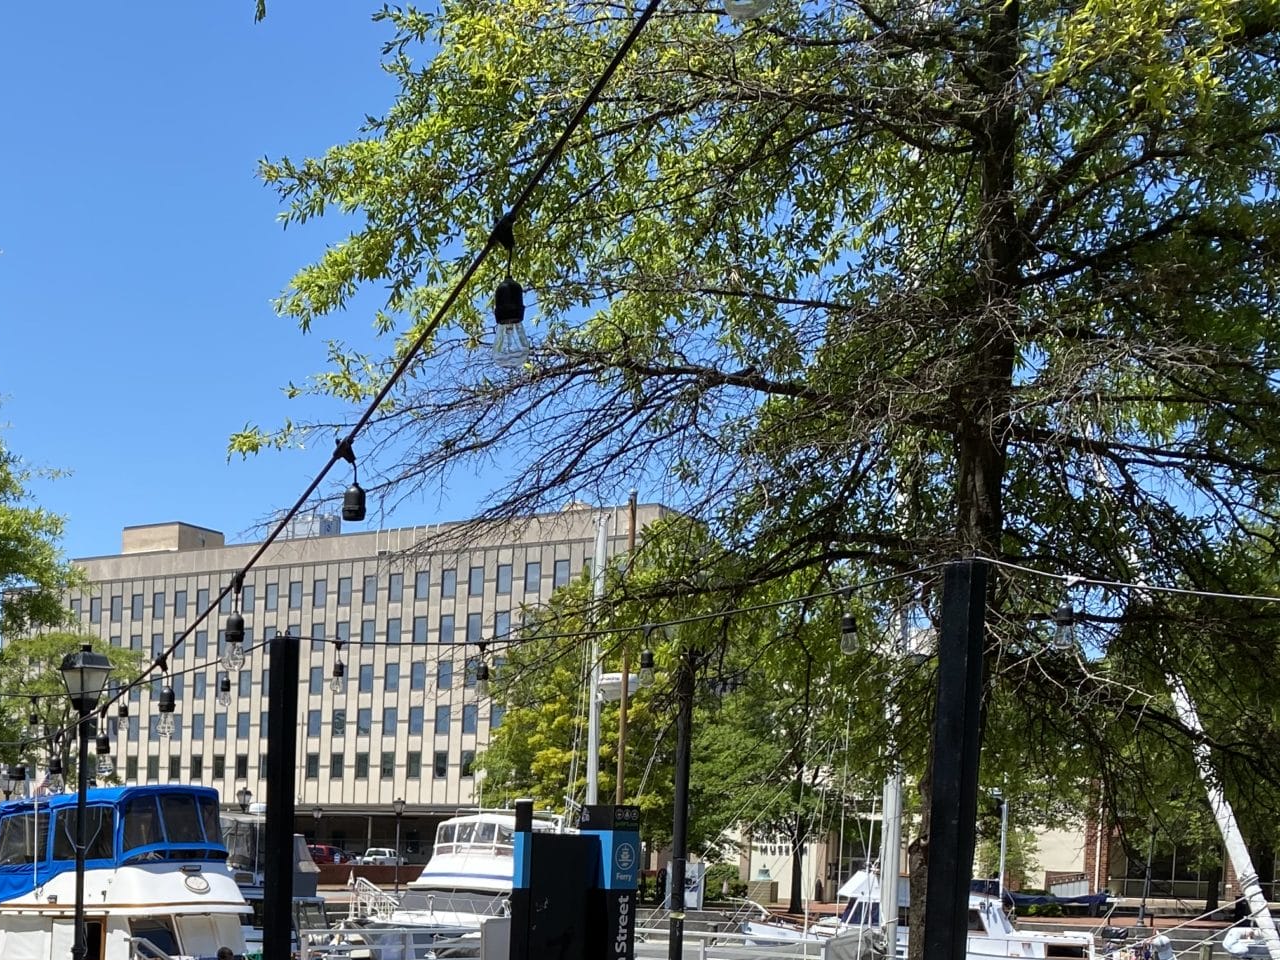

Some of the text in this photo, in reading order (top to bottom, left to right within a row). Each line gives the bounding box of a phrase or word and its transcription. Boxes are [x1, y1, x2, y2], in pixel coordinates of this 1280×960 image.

[760, 845, 808, 856] MUSEM
[616, 872, 633, 882] Ferry
[614, 894, 630, 953] Street
